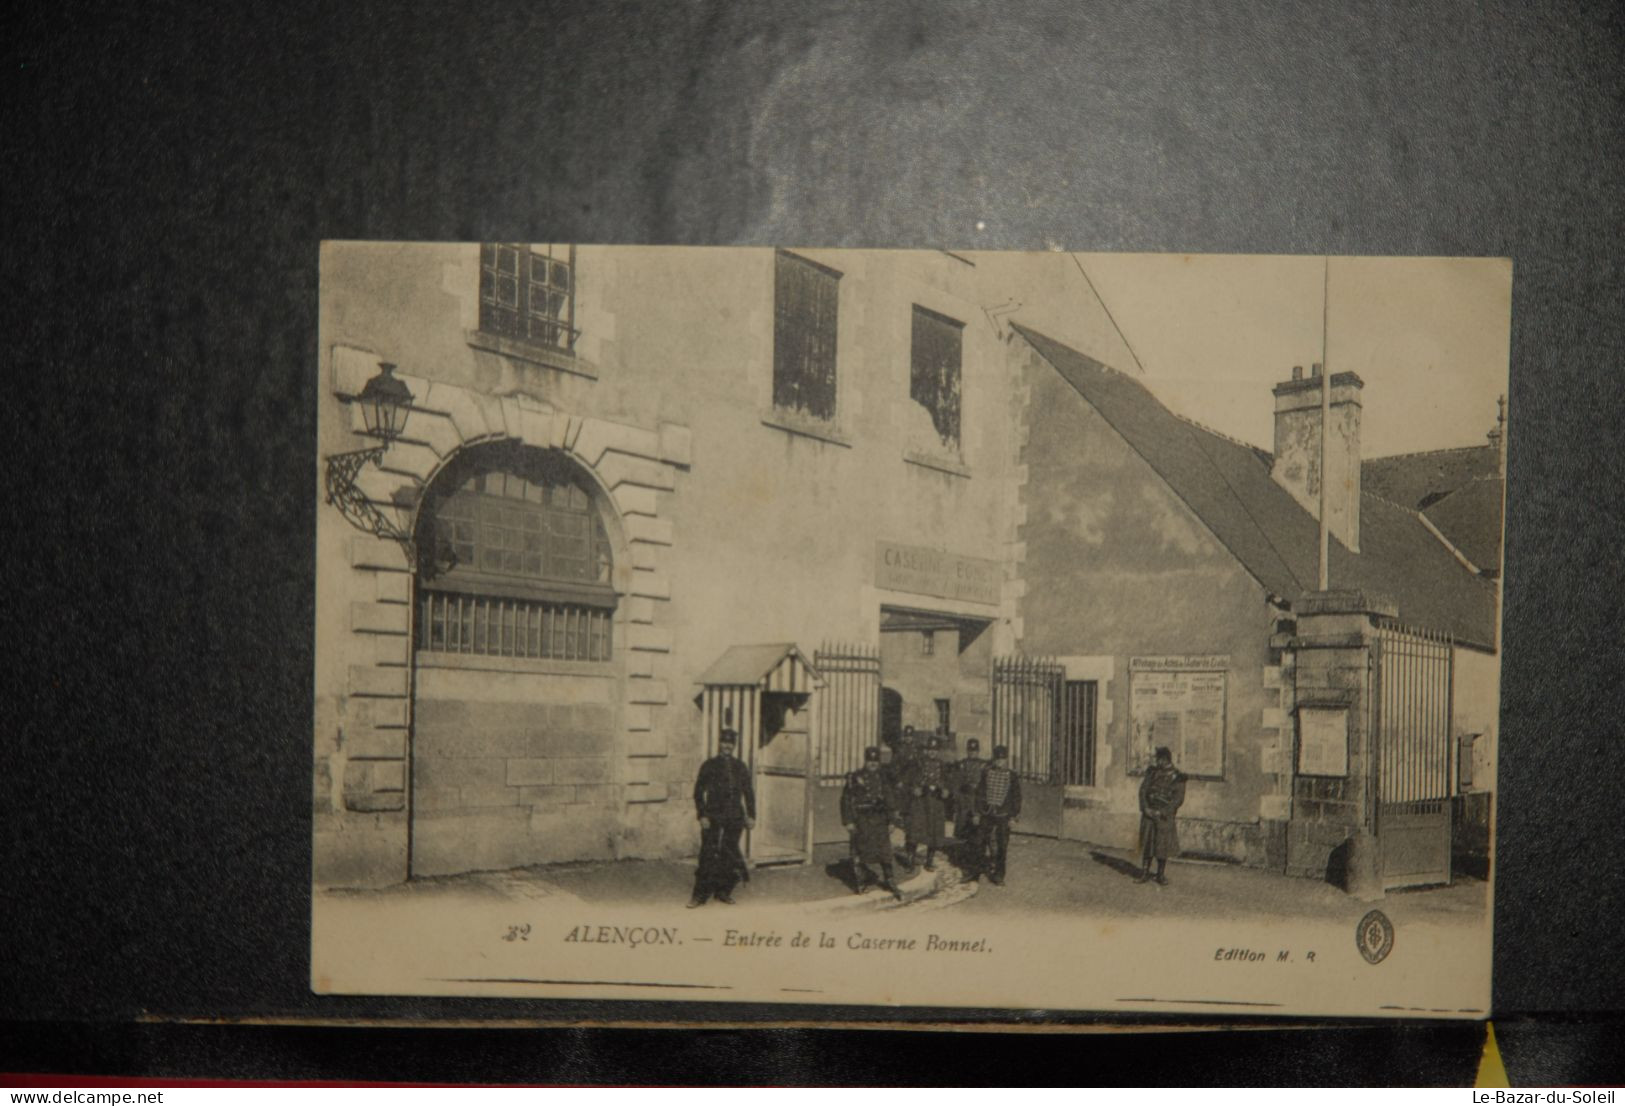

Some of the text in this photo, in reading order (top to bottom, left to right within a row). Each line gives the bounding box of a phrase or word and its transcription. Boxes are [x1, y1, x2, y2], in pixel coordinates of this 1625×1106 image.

[564, 926, 683, 949] ALENÇON.
[723, 930, 783, 949] Entrée
[791, 931, 811, 949] de
[819, 932, 836, 949] la
[847, 933, 917, 951] Caserne
[1214, 948, 1267, 963] Edition
